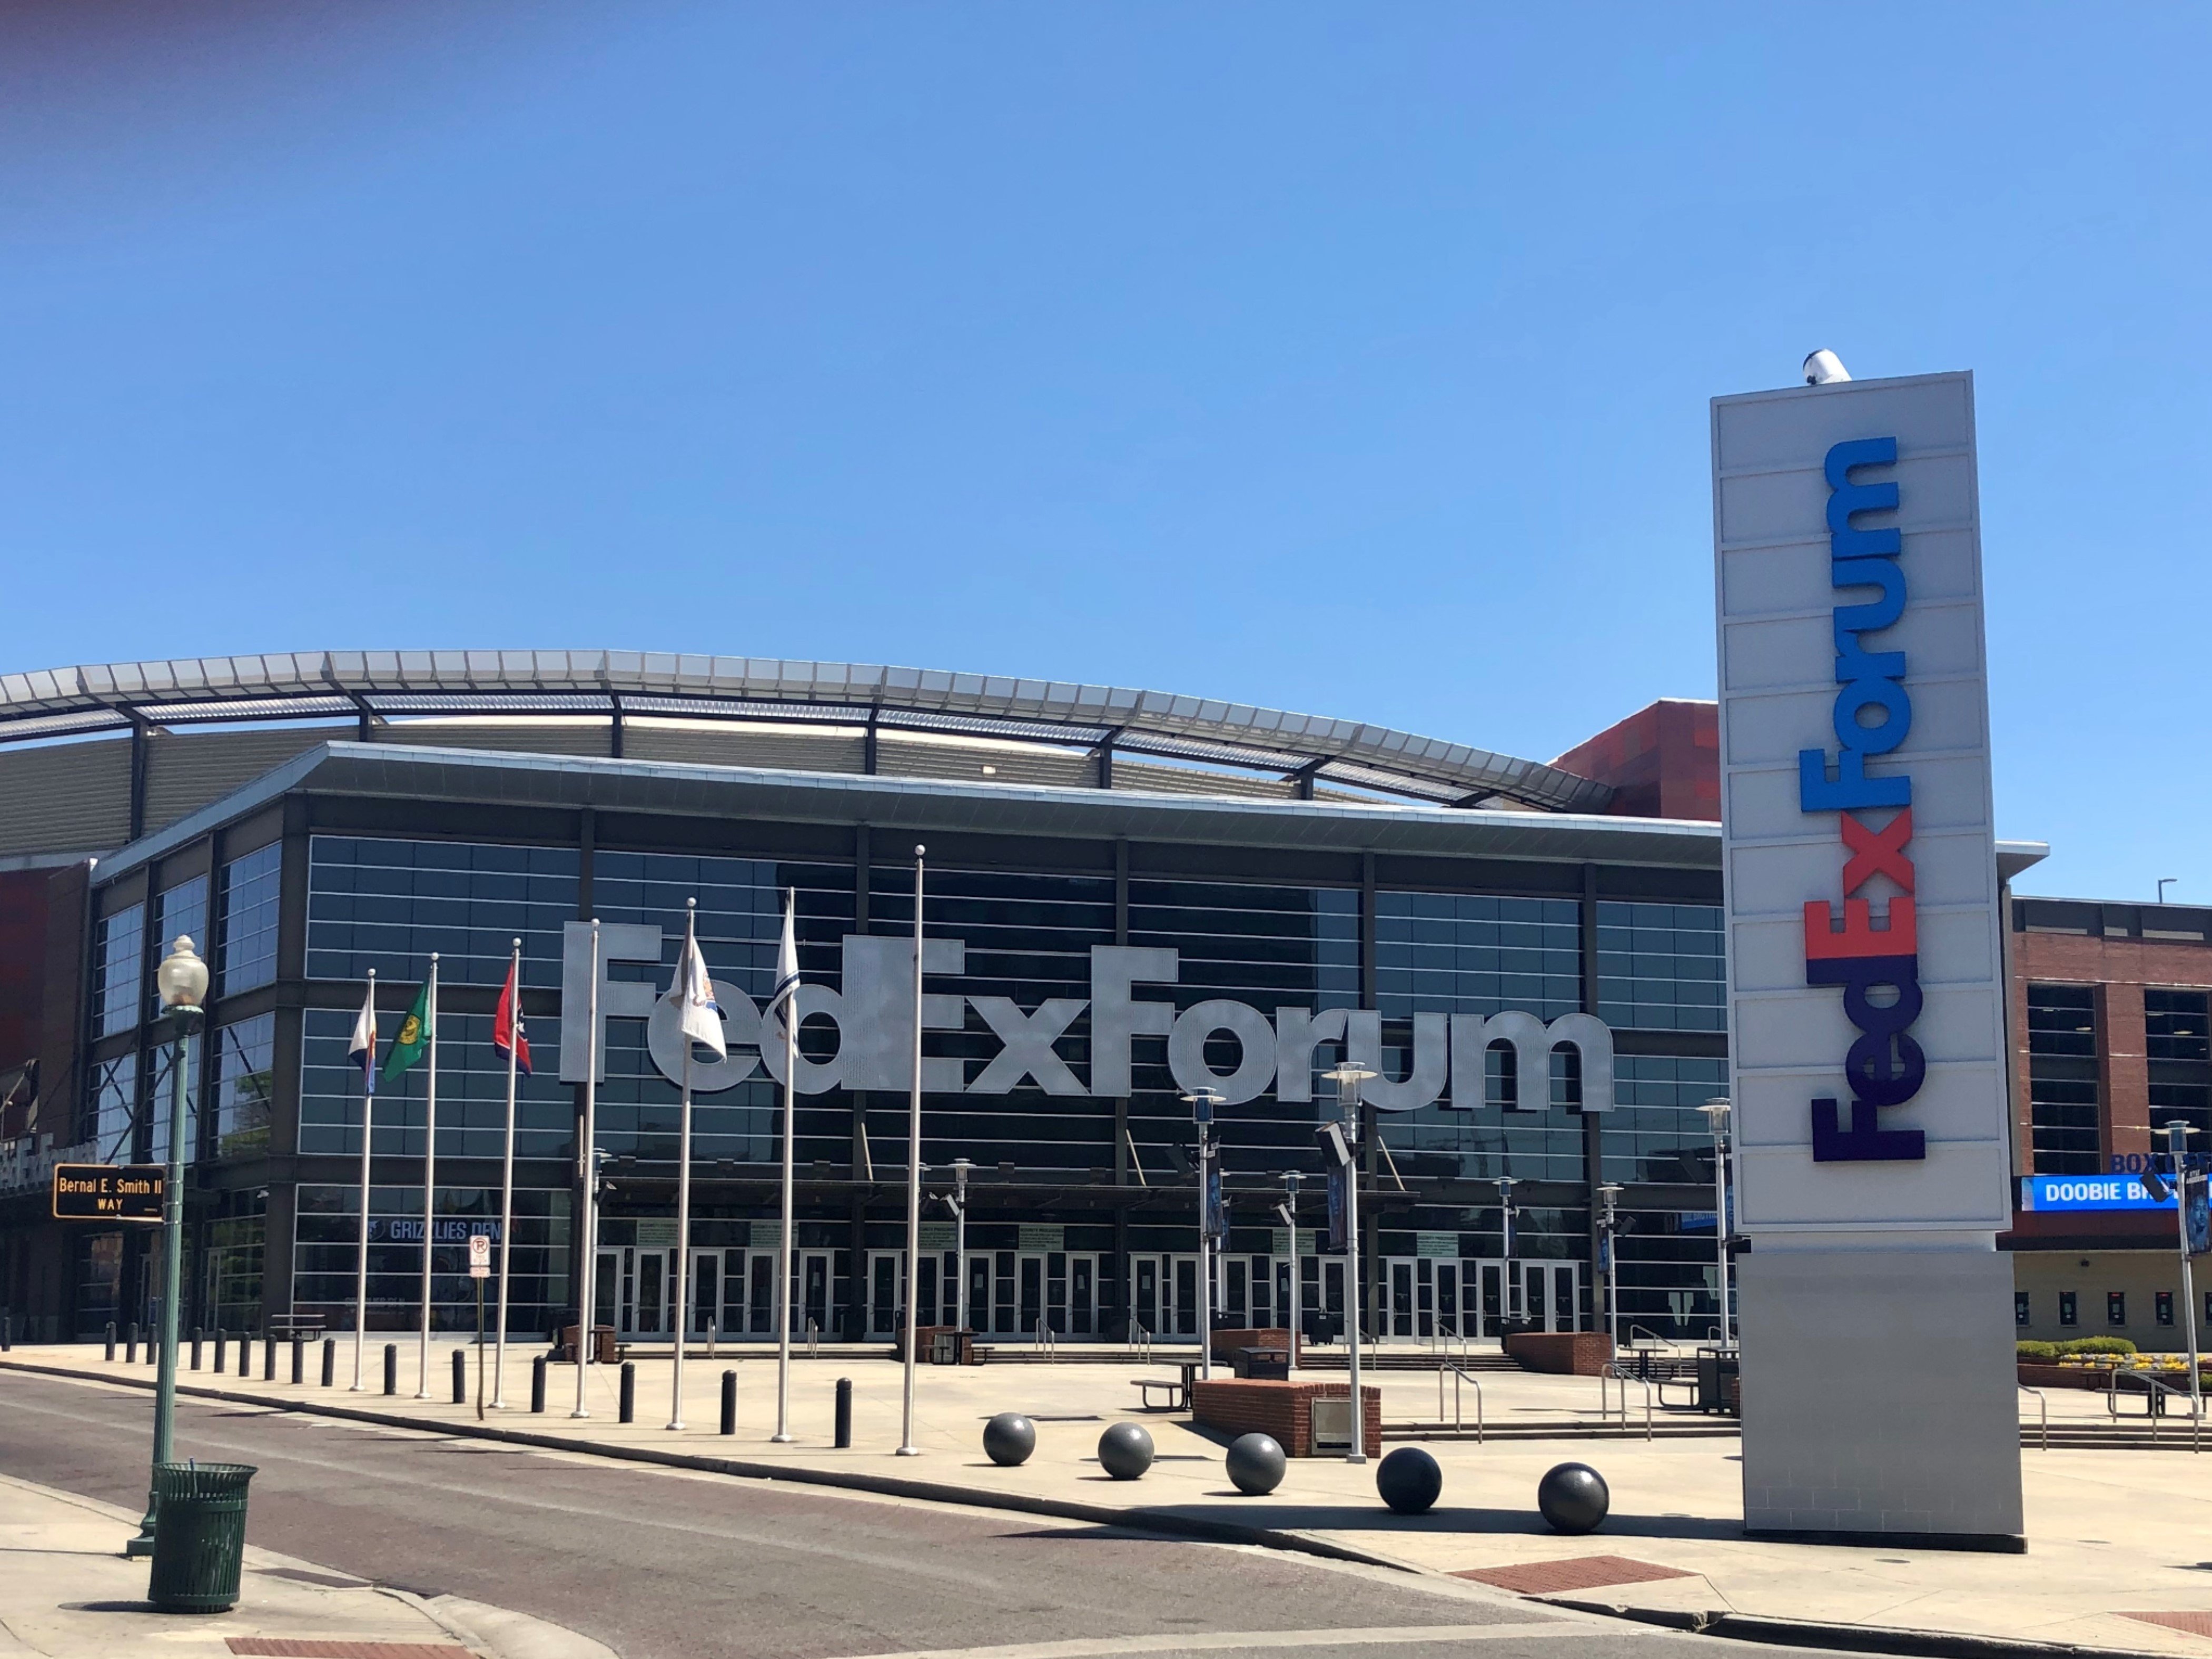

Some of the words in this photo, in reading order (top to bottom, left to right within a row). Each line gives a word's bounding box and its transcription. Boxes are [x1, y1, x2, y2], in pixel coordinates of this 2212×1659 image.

[1799, 436, 1926, 1162] FedExForum
[560, 921, 1615, 1112] FedExForum
[2110, 1153, 2157, 1174] BOX
[59, 1177, 96, 1192] Bernal
[101, 1178, 112, 1193] E.
[116, 1179, 150, 1194] Smith
[154, 1180, 162, 1194] II
[2046, 1182, 2121, 1201] DOOBIE
[97, 1198, 123, 1210] WAY
[390, 1221, 466, 1240] GRIZLIES
